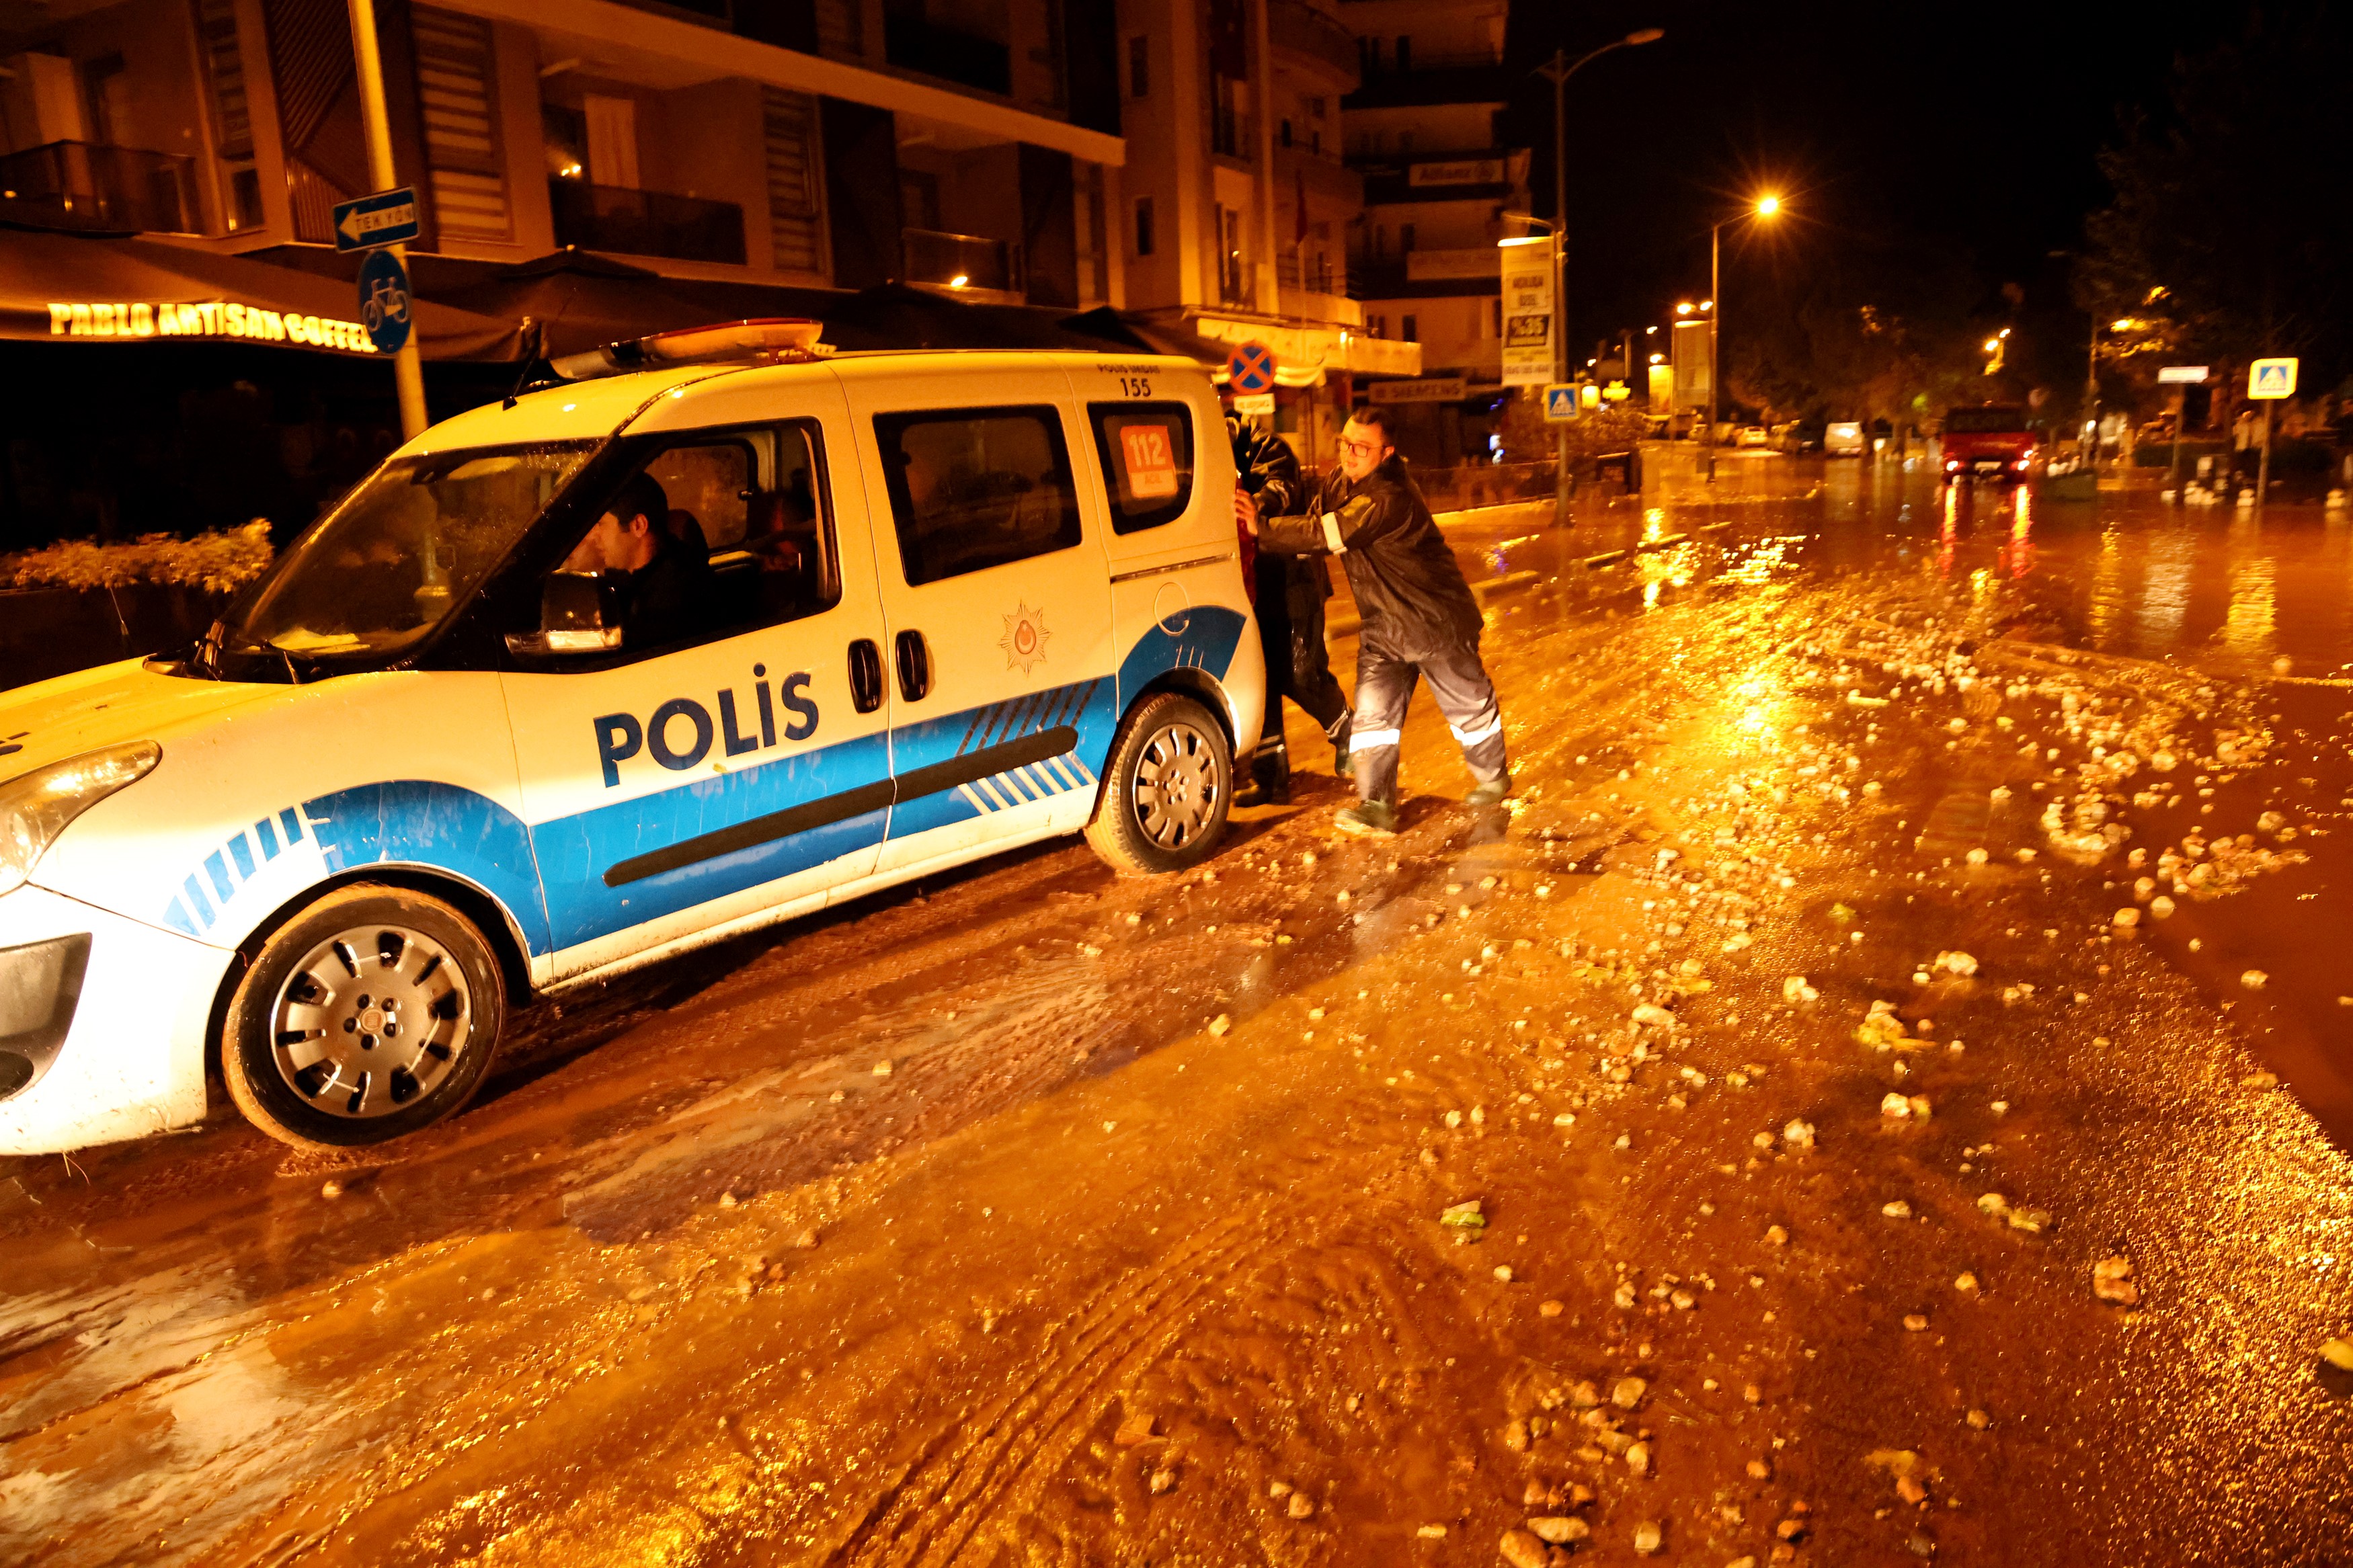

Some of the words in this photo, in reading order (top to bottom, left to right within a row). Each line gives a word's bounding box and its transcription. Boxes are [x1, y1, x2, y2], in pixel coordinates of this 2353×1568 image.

[355, 215, 381, 231] TEK
[47, 302, 155, 336] PABLO
[158, 302, 286, 341] ARTISAN
[1120, 378, 1152, 397] 155
[1129, 433, 1166, 468] 112
[594, 663, 820, 788] POLİS
